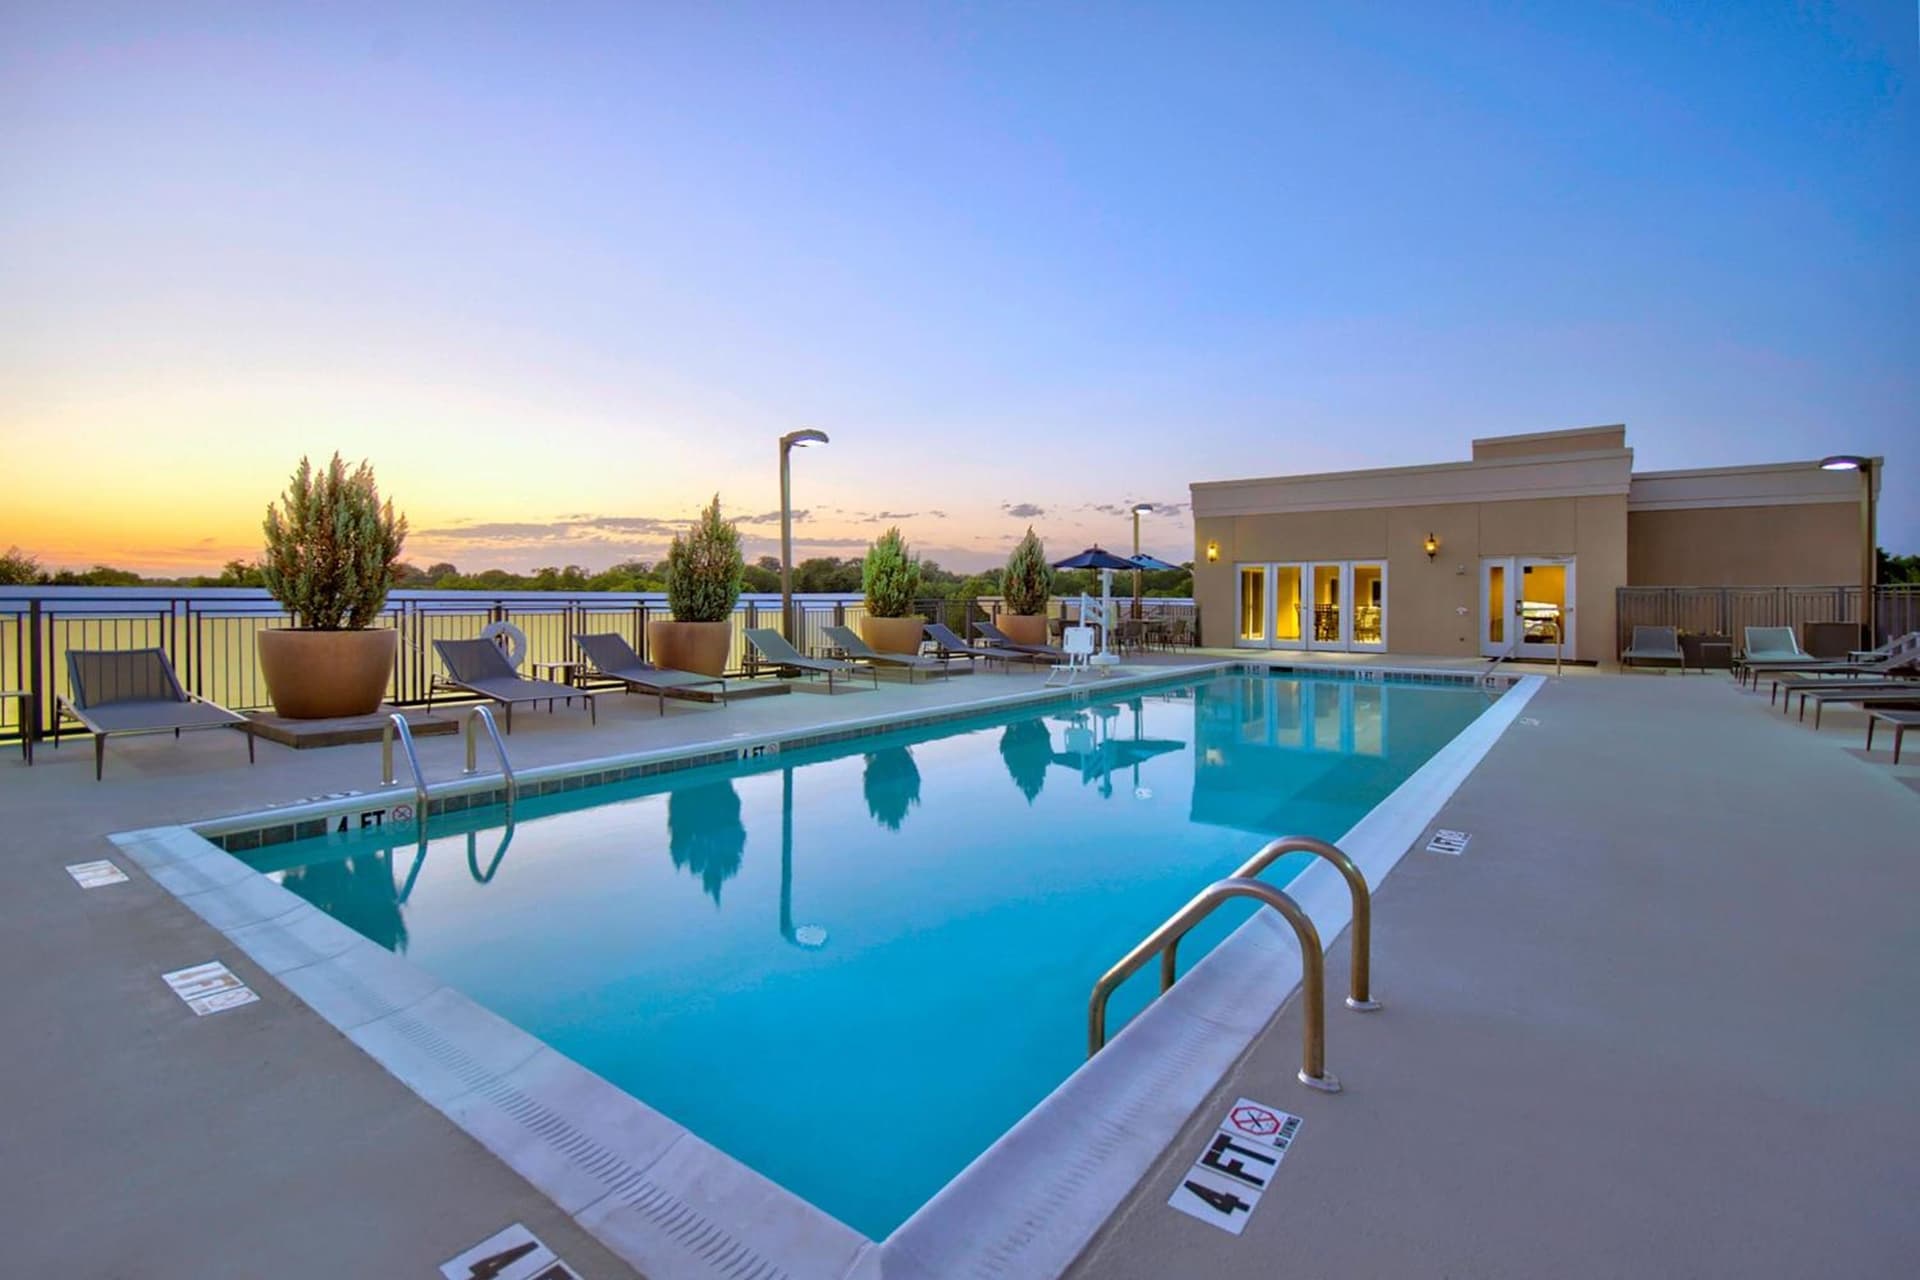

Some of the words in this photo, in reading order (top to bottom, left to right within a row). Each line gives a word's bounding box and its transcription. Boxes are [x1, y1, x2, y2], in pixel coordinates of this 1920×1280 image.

[337, 815, 348, 832] 4
[361, 809, 386, 830] FT
[1201, 1133, 1277, 1187] FT
[1184, 1180, 1250, 1216] 4
[467, 1240, 540, 1280] 4
